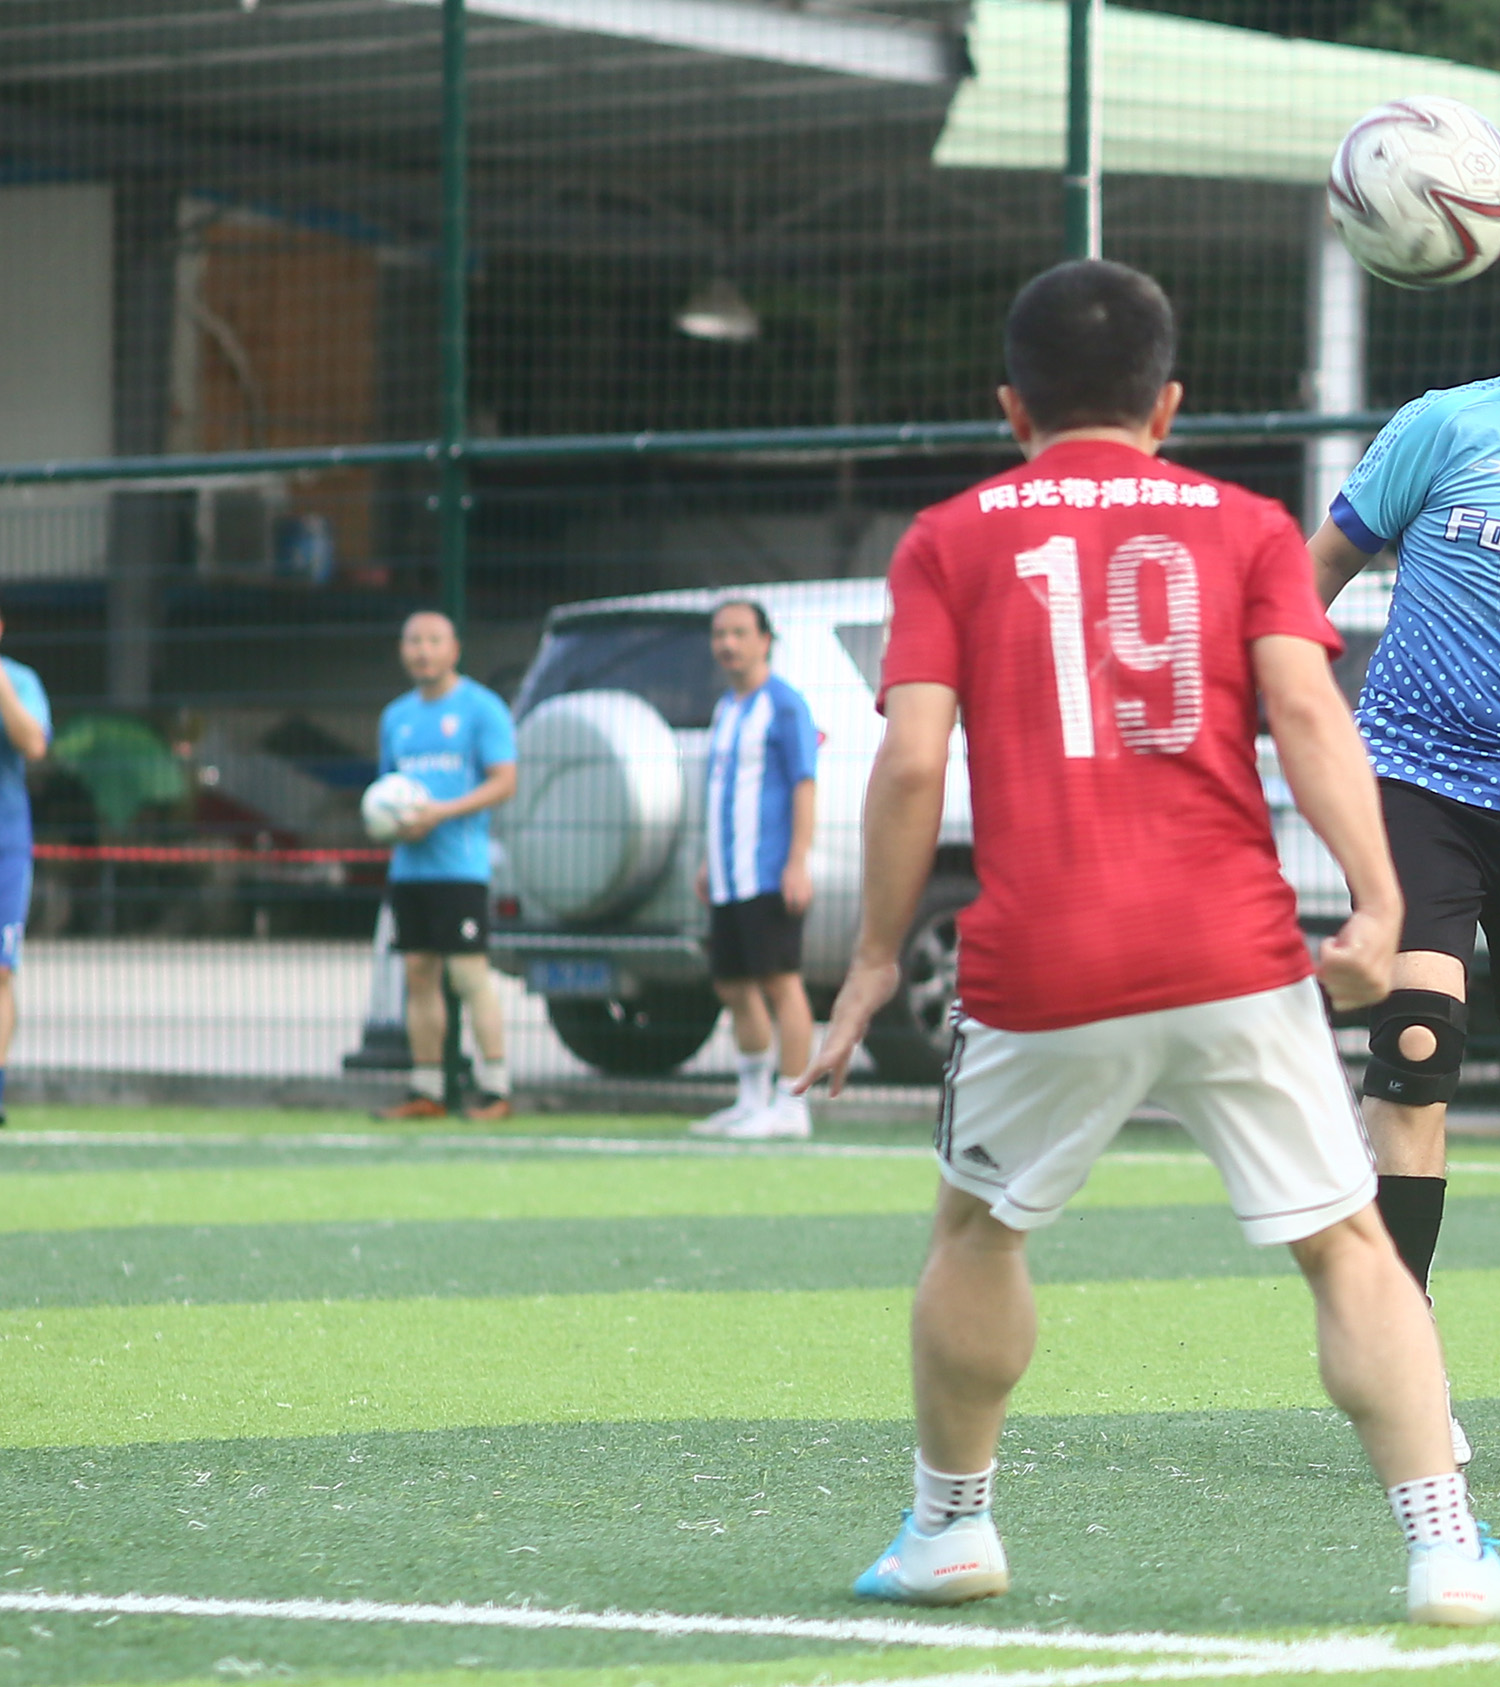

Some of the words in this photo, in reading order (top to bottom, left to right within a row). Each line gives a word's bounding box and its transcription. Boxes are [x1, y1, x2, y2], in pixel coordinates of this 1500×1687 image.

[978, 477, 1221, 513] 阳光带海滨城
[1014, 534, 1203, 759] 19
